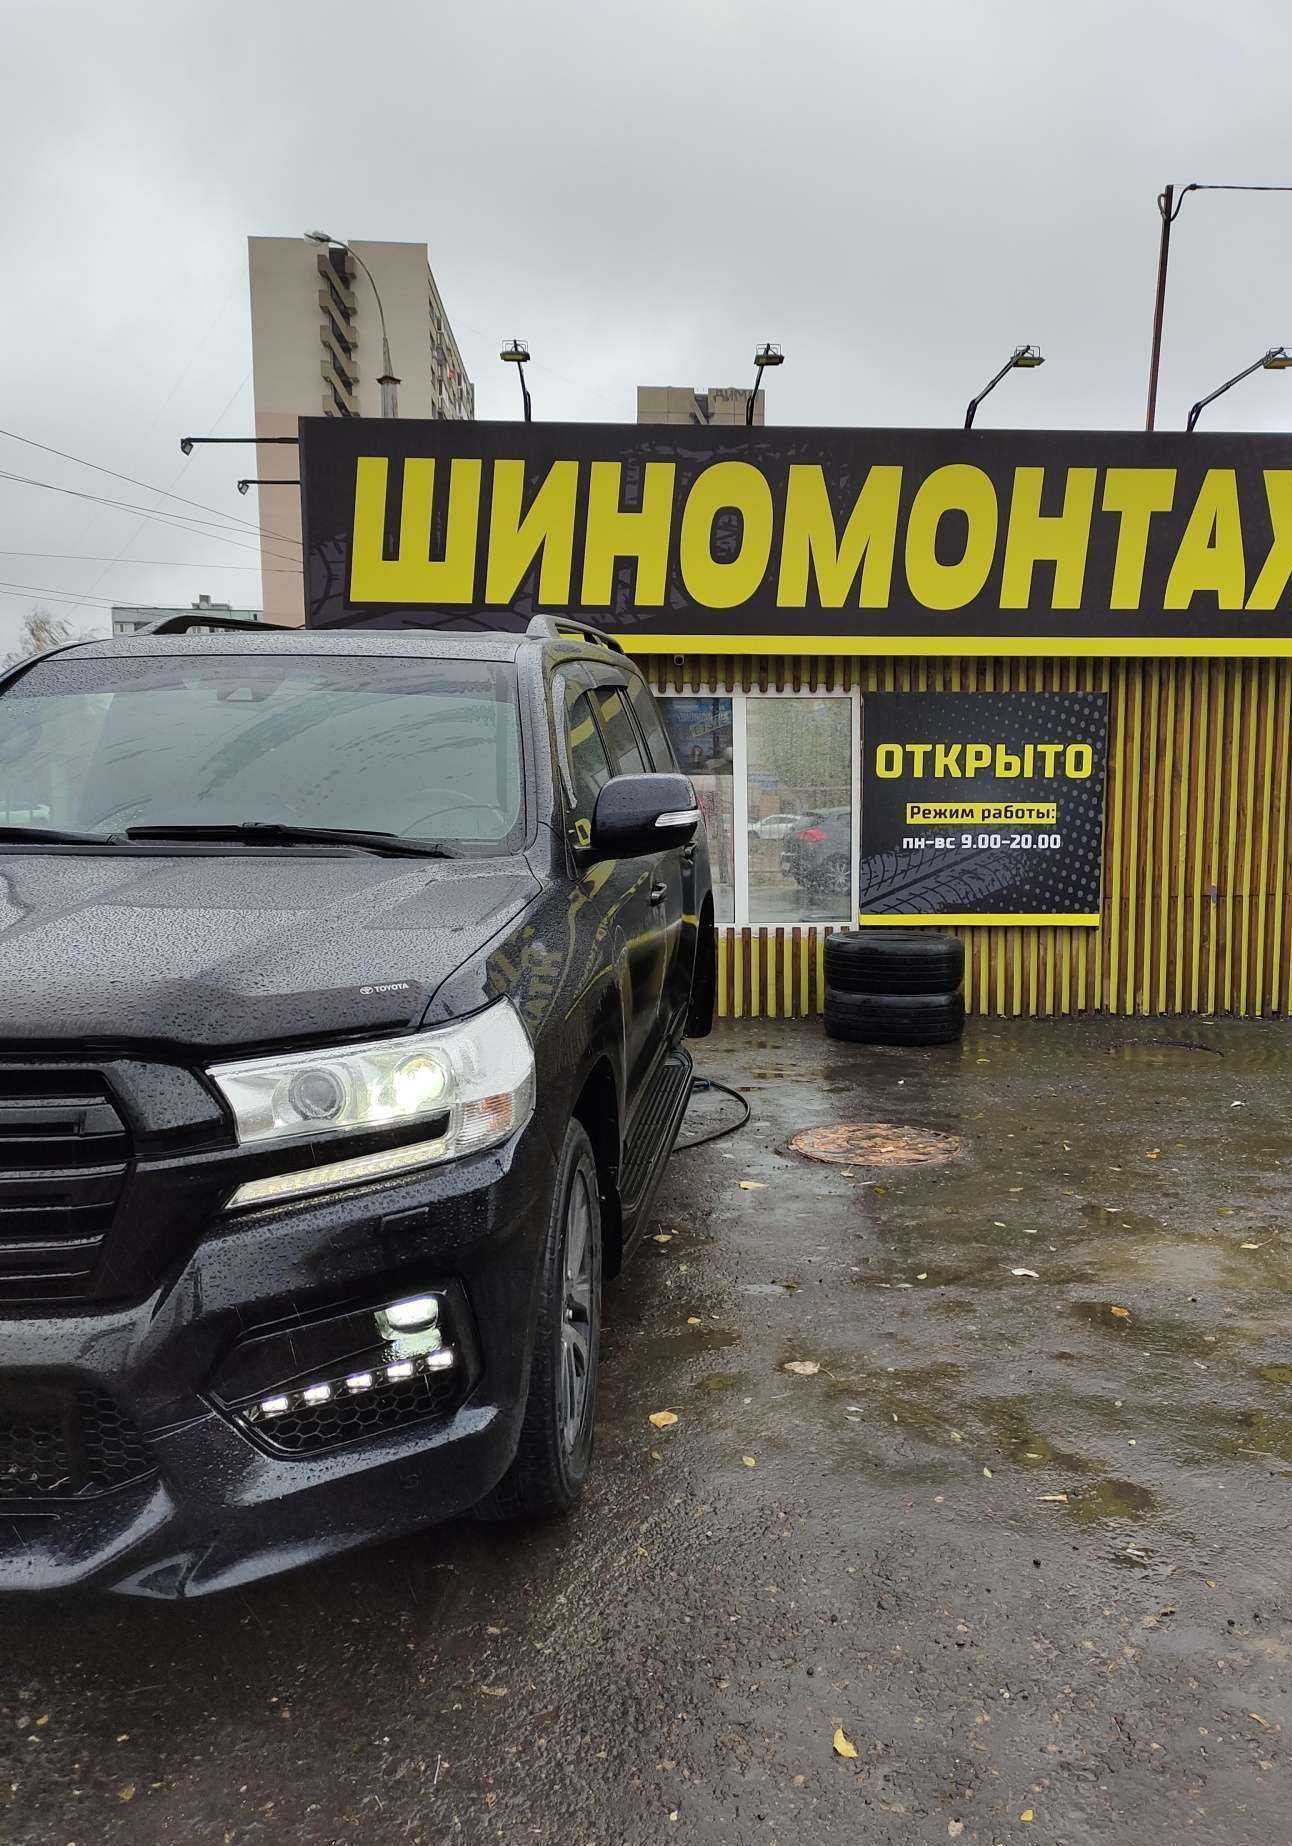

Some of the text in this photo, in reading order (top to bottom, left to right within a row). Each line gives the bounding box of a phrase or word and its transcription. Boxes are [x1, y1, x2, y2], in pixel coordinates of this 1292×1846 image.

[875, 743, 1094, 779] ОТКРЫТО
[910, 804, 1057, 821] Режим работы:
[902, 833, 1061, 849] пн-вс 9.00-20.00
[374, 983, 409, 992] TOYOTA
